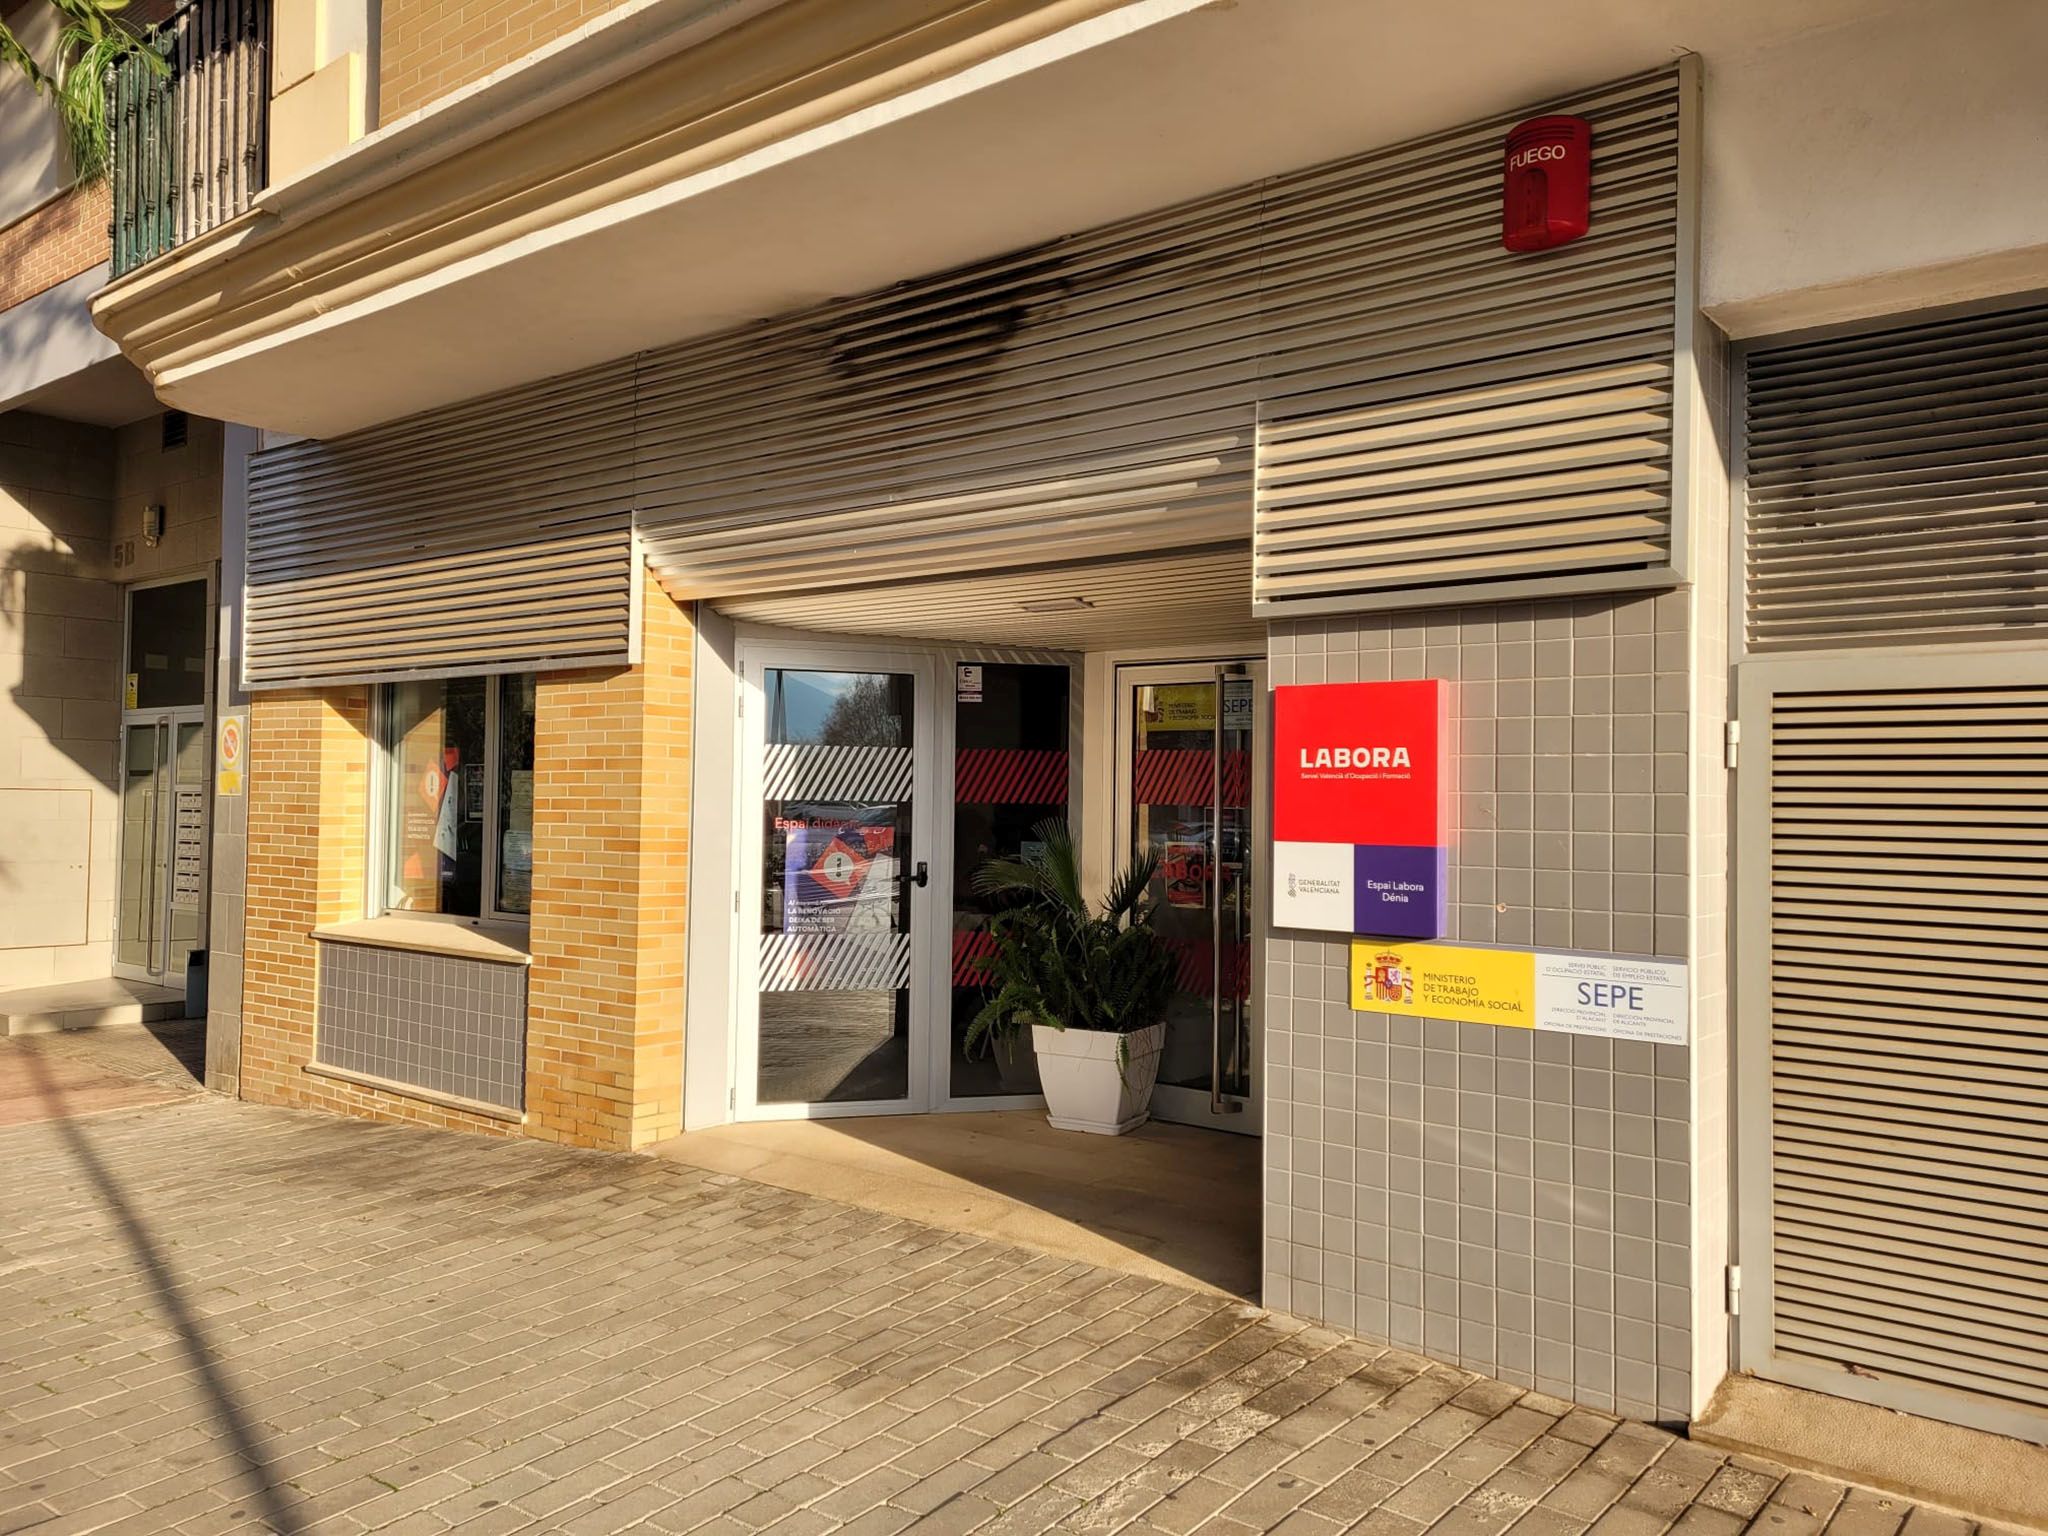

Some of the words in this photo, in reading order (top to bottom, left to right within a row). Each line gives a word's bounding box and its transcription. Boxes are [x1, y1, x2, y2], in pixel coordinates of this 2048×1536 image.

[1510, 144, 1566, 172] FUEGO
[1300, 747, 1411, 768] LABORA
[774, 817, 808, 832] Espai
[1298, 879, 1340, 887] GENERALITAT
[1367, 880, 1391, 891] Espai
[1392, 881, 1424, 892] Labora
[1382, 892, 1408, 903] Dénia
[1423, 972, 1476, 985] MINISTERIO
[1423, 983, 1436, 992] DE
[1437, 984, 1479, 998] TRABAJO
[1578, 982, 1643, 1010] SEPE
[1432, 995, 1485, 1008] ECONOMÍA
[1488, 1000, 1523, 1012] SOCIAL
